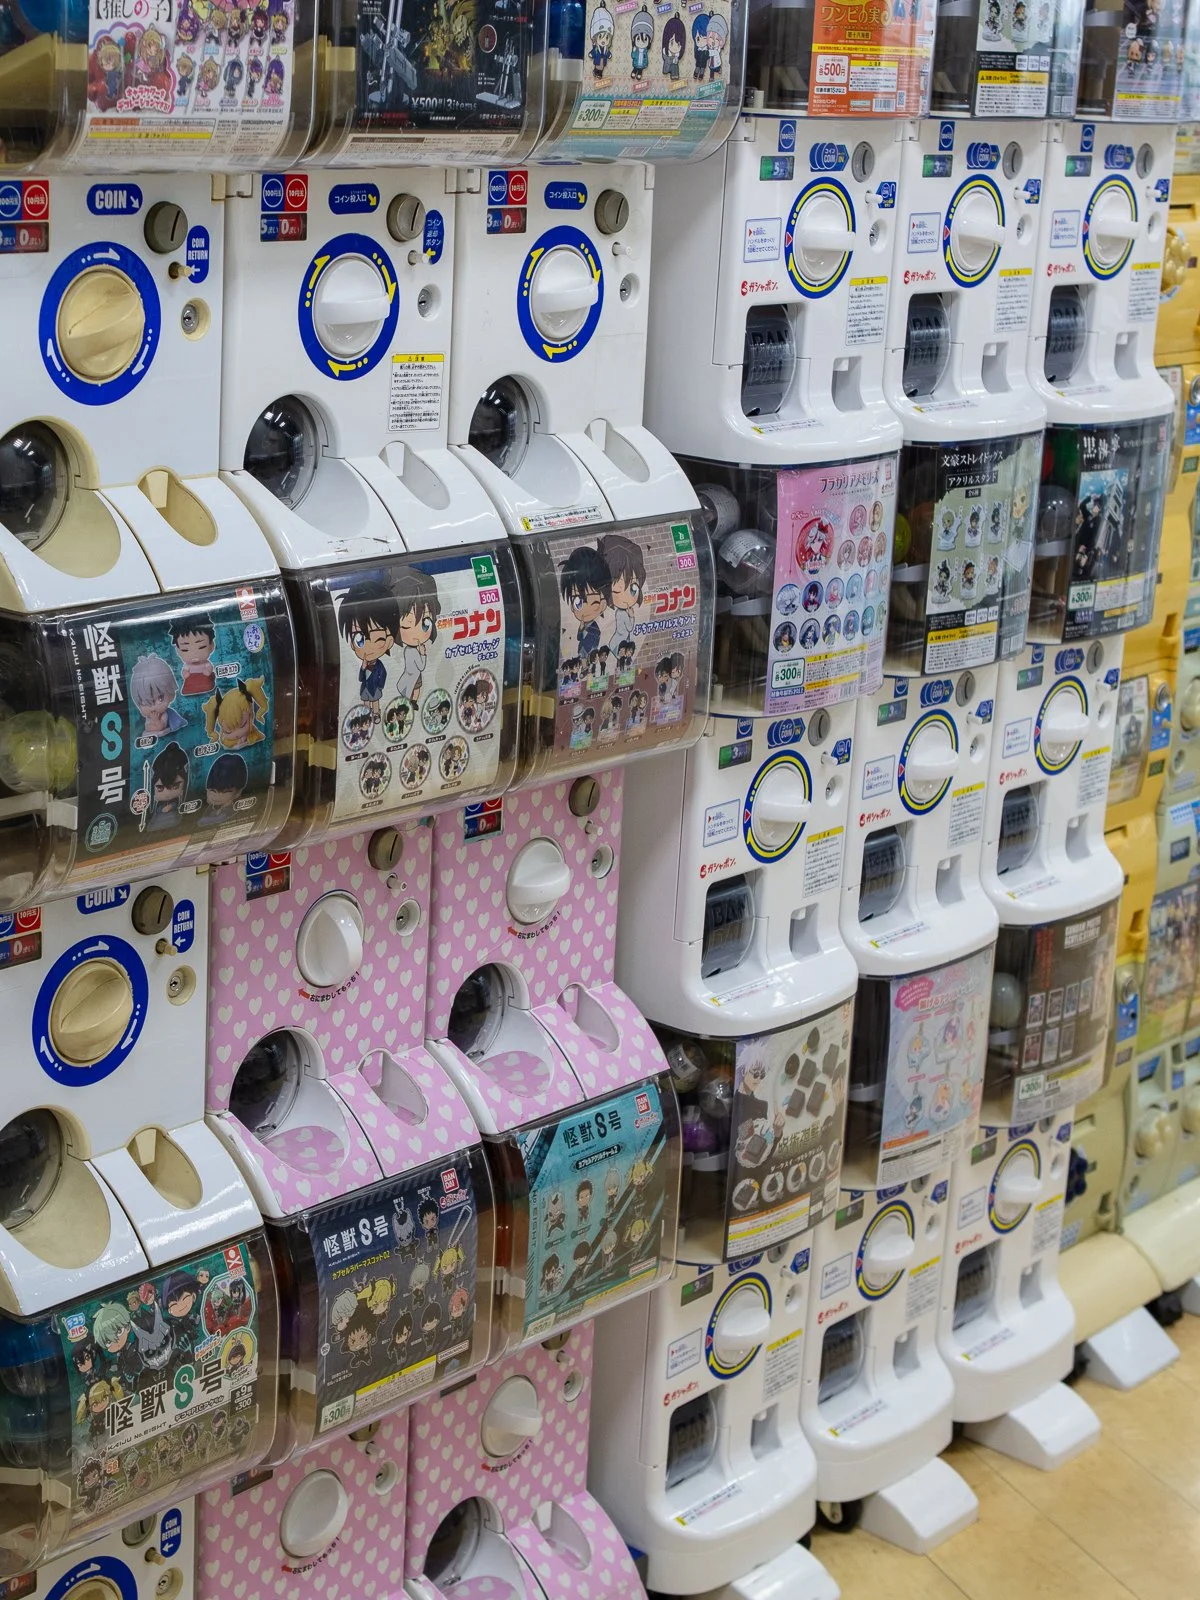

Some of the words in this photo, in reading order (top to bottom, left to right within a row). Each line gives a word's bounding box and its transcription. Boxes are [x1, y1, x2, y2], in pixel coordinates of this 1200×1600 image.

[824, 155, 836, 163] COIN
[95, 190, 127, 210] COIN
[334, 193, 367, 205] コイン投入口
[549, 190, 578, 200] コイン投入口
[426, 218, 441, 228] コイン
[192, 238, 206, 249] COIN
[188, 249, 208, 261] RETURN
[948, 474, 998, 486] アクリルスタンド
[655, 585, 697, 614] コナン
[453, 609, 502, 641] コナン
[83, 620, 127, 805] 怪獣8号
[781, 729, 794, 738] COIN
[176, 909, 191, 922] COIN
[172, 919, 195, 934] RETURN
[563, 1110, 622, 1150] 怪獣8号
[323, 1215, 390, 1259] 怪獣8号
[105, 1361, 226, 1437] 怪獣8号
[107, 1438, 132, 1452] KAIJU
[165, 1517, 178, 1530] COIN
[161, 1526, 182, 1542] RETURN
